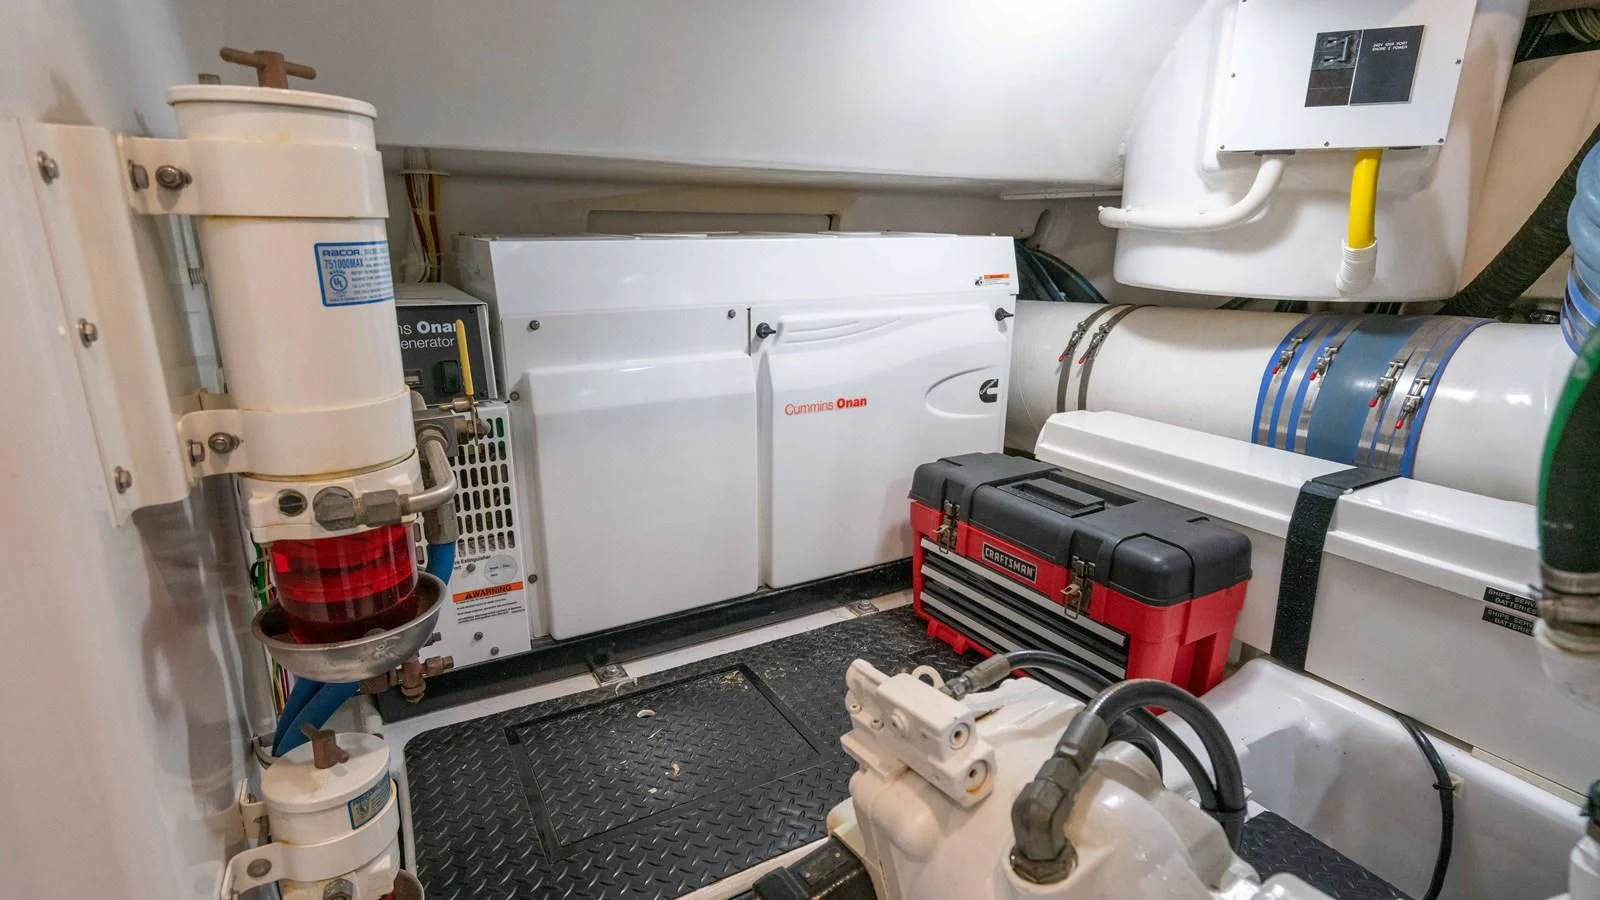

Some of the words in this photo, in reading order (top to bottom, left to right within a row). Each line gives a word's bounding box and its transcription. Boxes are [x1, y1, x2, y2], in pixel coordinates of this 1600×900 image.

[400, 337, 455, 349] enerator
[784, 400, 834, 416] Cummins
[836, 397, 867, 409] Onan
[985, 547, 1034, 578] CRAFTSMAN
[472, 584, 512, 599] WARNING
